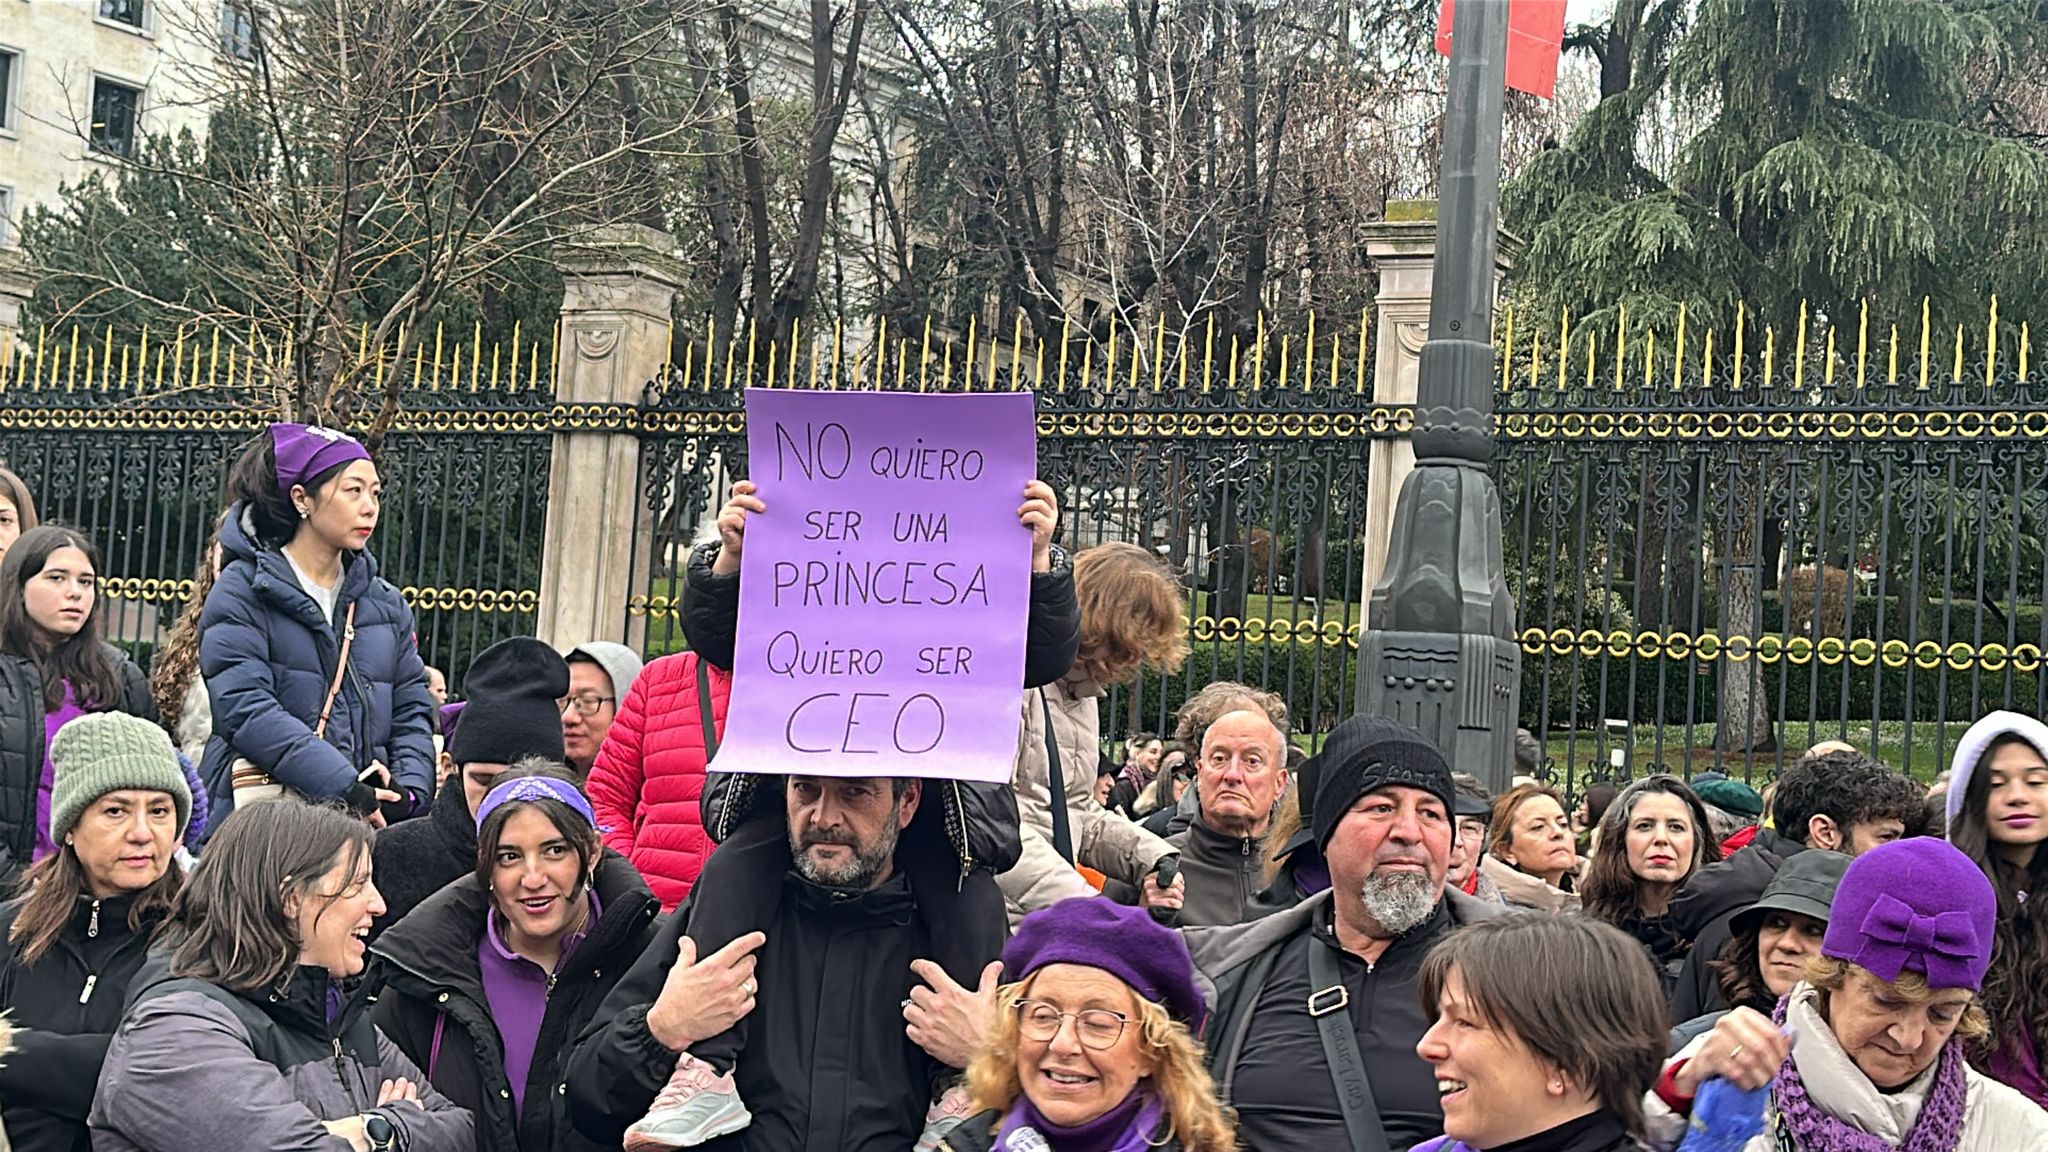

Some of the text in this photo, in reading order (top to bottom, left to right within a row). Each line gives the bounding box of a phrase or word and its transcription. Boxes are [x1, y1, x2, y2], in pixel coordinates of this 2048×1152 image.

[776, 422, 983, 481] NO QUIERO
[804, 511, 947, 543] SER UNA
[775, 551, 988, 607] PRINCESA
[916, 647, 972, 674] SER
[786, 693, 944, 754] CEO
